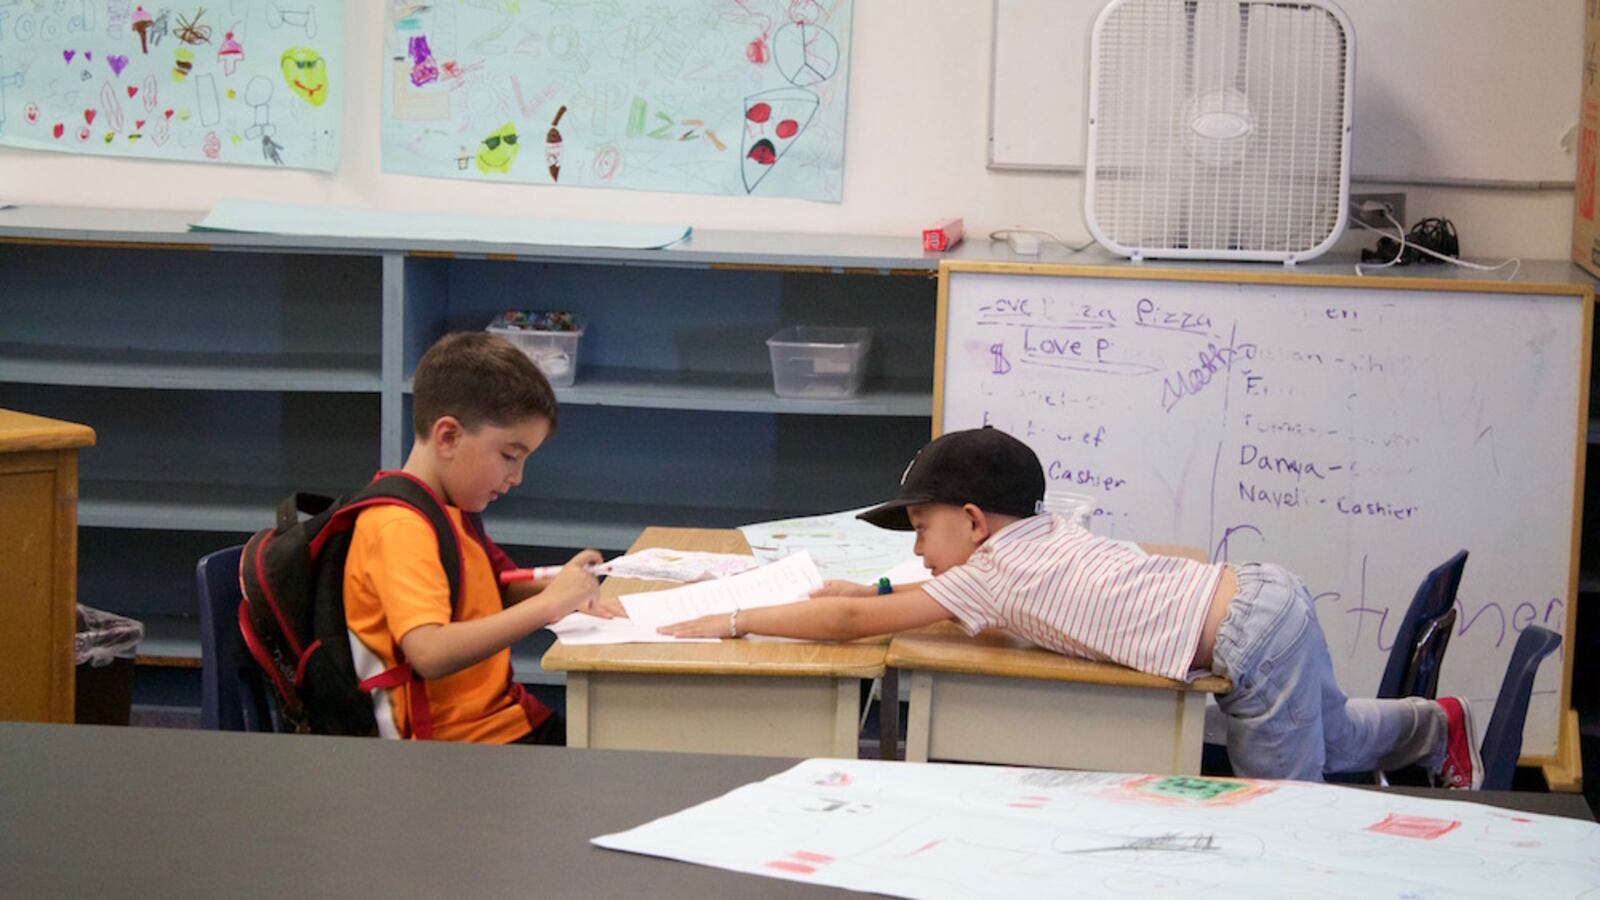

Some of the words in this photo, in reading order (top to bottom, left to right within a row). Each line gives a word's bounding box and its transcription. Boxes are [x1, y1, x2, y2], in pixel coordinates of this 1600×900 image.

[1136, 298, 1212, 328] Pizza
[1023, 328, 1082, 356] Love
[1047, 459, 1127, 491] Cashier
[1336, 495, 1419, 520] Cashier
